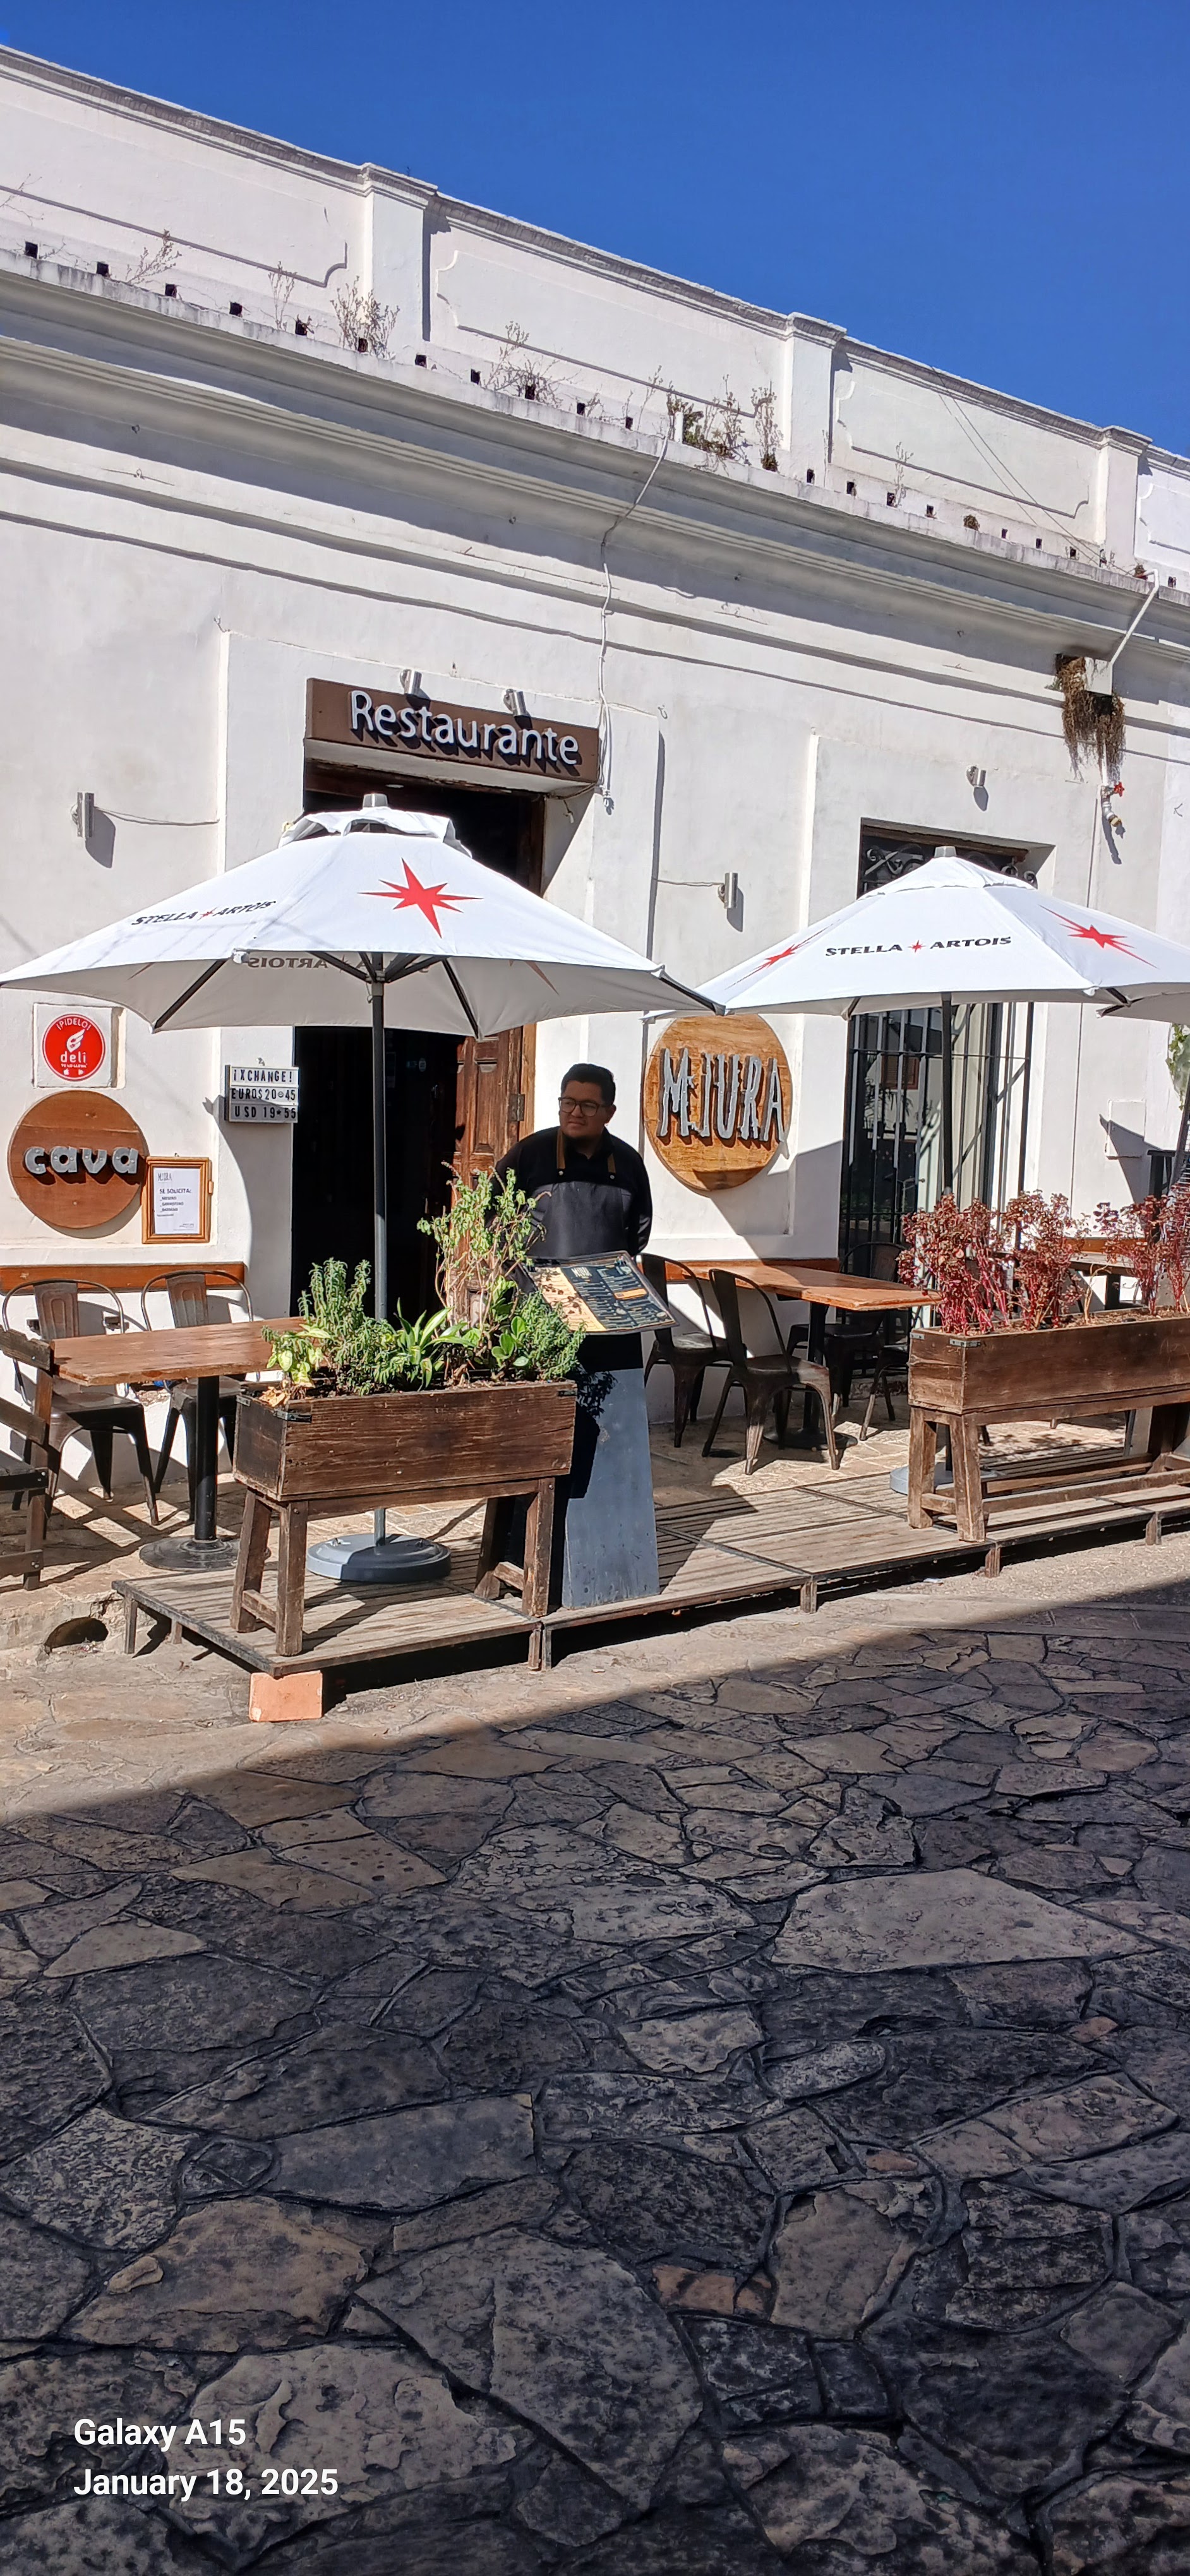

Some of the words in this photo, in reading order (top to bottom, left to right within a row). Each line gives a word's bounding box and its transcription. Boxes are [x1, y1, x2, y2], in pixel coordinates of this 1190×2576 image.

[351, 690, 579, 765] Restaurante
[131, 911, 198, 925] STELLA
[212, 901, 276, 917] ARTOIS
[826, 944, 903, 957] STELLA
[930, 936, 1011, 949] ARTOIS
[60, 1051, 86, 1063] deli
[234, 1106, 256, 1118] USD
[24, 1146, 138, 1174] cava
